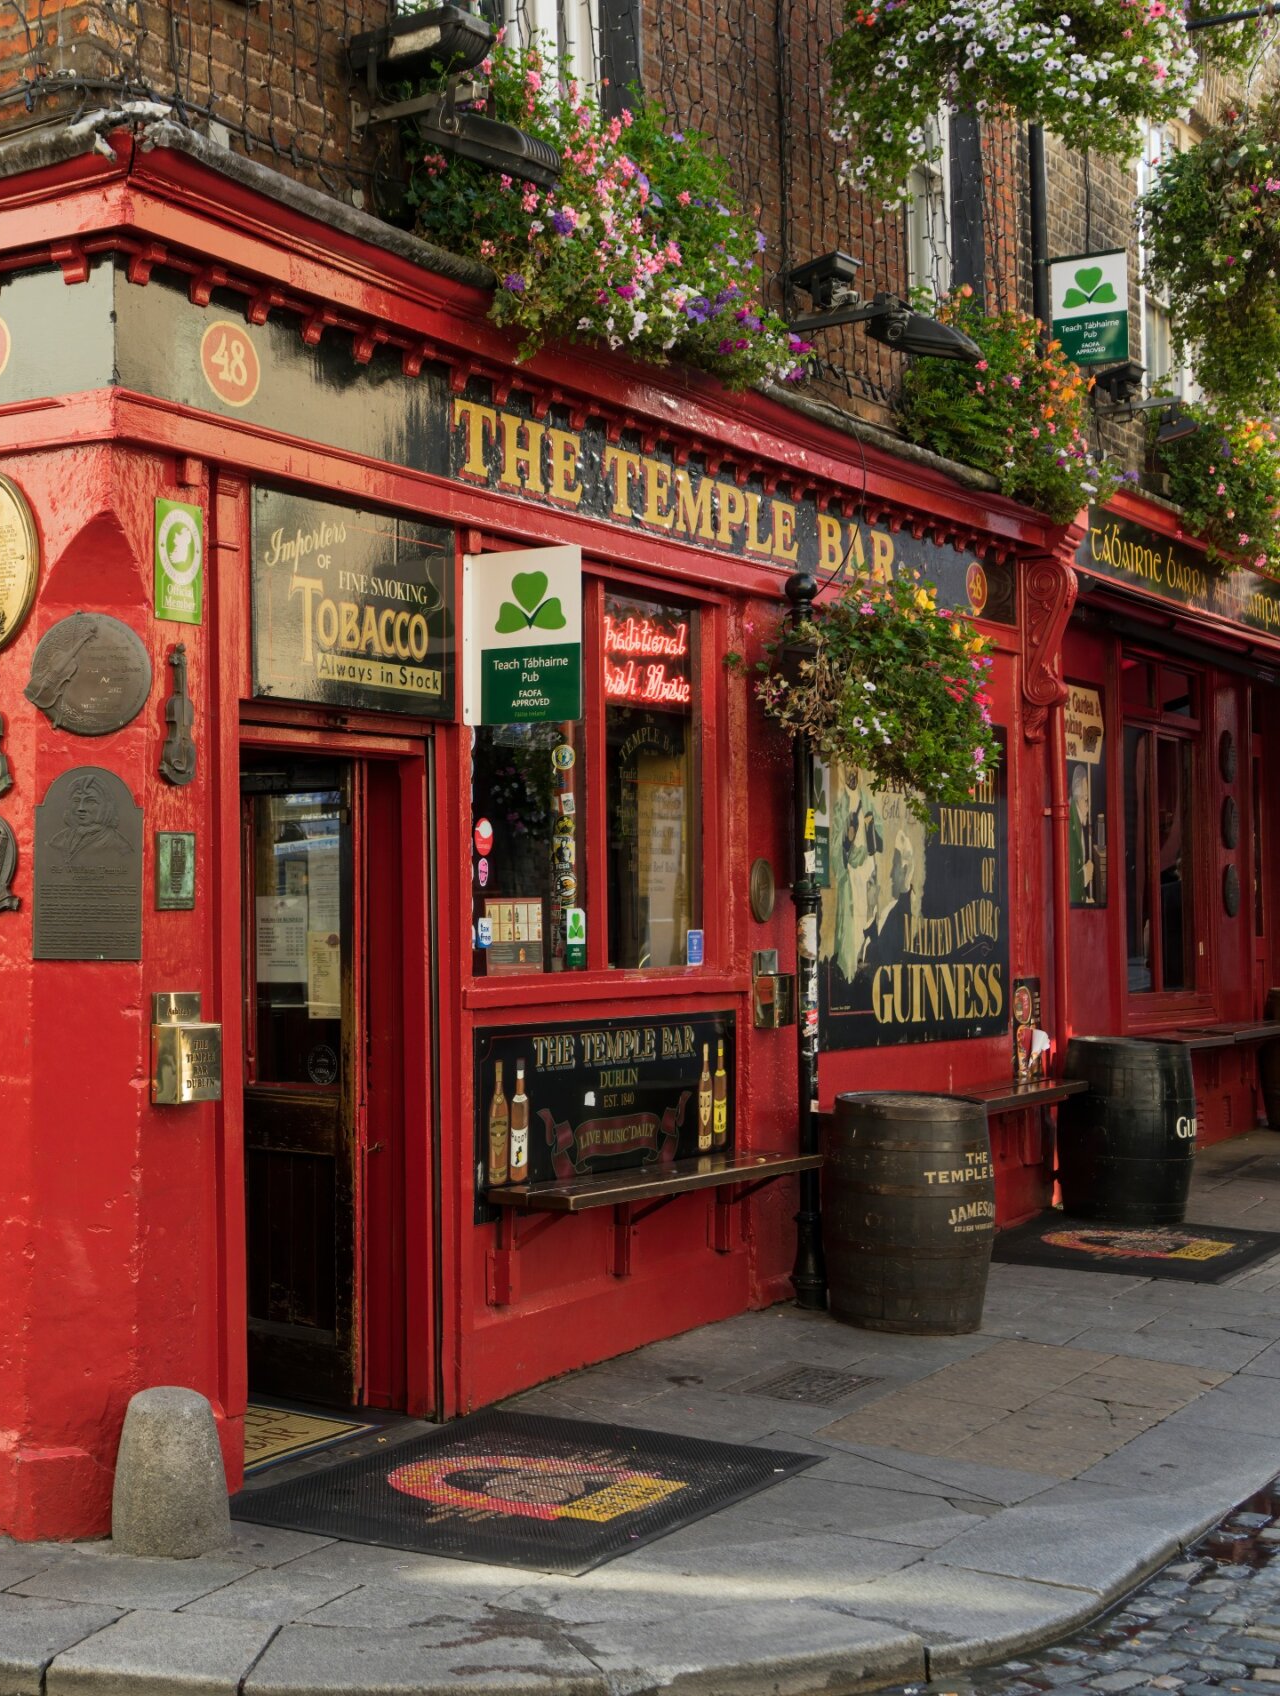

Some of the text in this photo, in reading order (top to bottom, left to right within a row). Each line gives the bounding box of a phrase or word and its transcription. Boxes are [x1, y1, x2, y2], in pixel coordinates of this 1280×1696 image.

[1061, 323, 1083, 333] Teach
[1083, 330, 1098, 339] Pub
[210, 333, 248, 387] 48
[452, 398, 896, 584] THE TEMPLE BAR
[264, 520, 347, 573] Importers
[317, 554, 332, 570] OF
[339, 570, 428, 605] FINE SMOKING
[968, 572, 984, 601] 48
[319, 656, 439, 691] Always in Stock
[493, 656, 569, 671] Teach Tábhairne
[521, 671, 540, 683] Pub
[511, 697, 551, 708] APPROVED
[518, 689, 543, 698] FAOFA
[619, 726, 660, 763] TEMPLE
[939, 807, 996, 850] EMPEROR
[981, 856, 996, 894] OF
[480, 923, 489, 932] tax
[480, 932, 492, 942] free
[903, 898, 1001, 957] MALTED LIQUORS
[872, 963, 1004, 1025] GUINNESS
[532, 1024, 697, 1071] THE TEMPLE BAR
[186, 1077, 216, 1089] DUBLIN
[600, 1067, 639, 1090] DUBLIN
[603, 1093, 620, 1108] EST.
[579, 1122, 657, 1149] LIVE MUSIC DAILY
[965, 1151, 988, 1165] THE
[923, 1167, 988, 1184] TEMPLE
